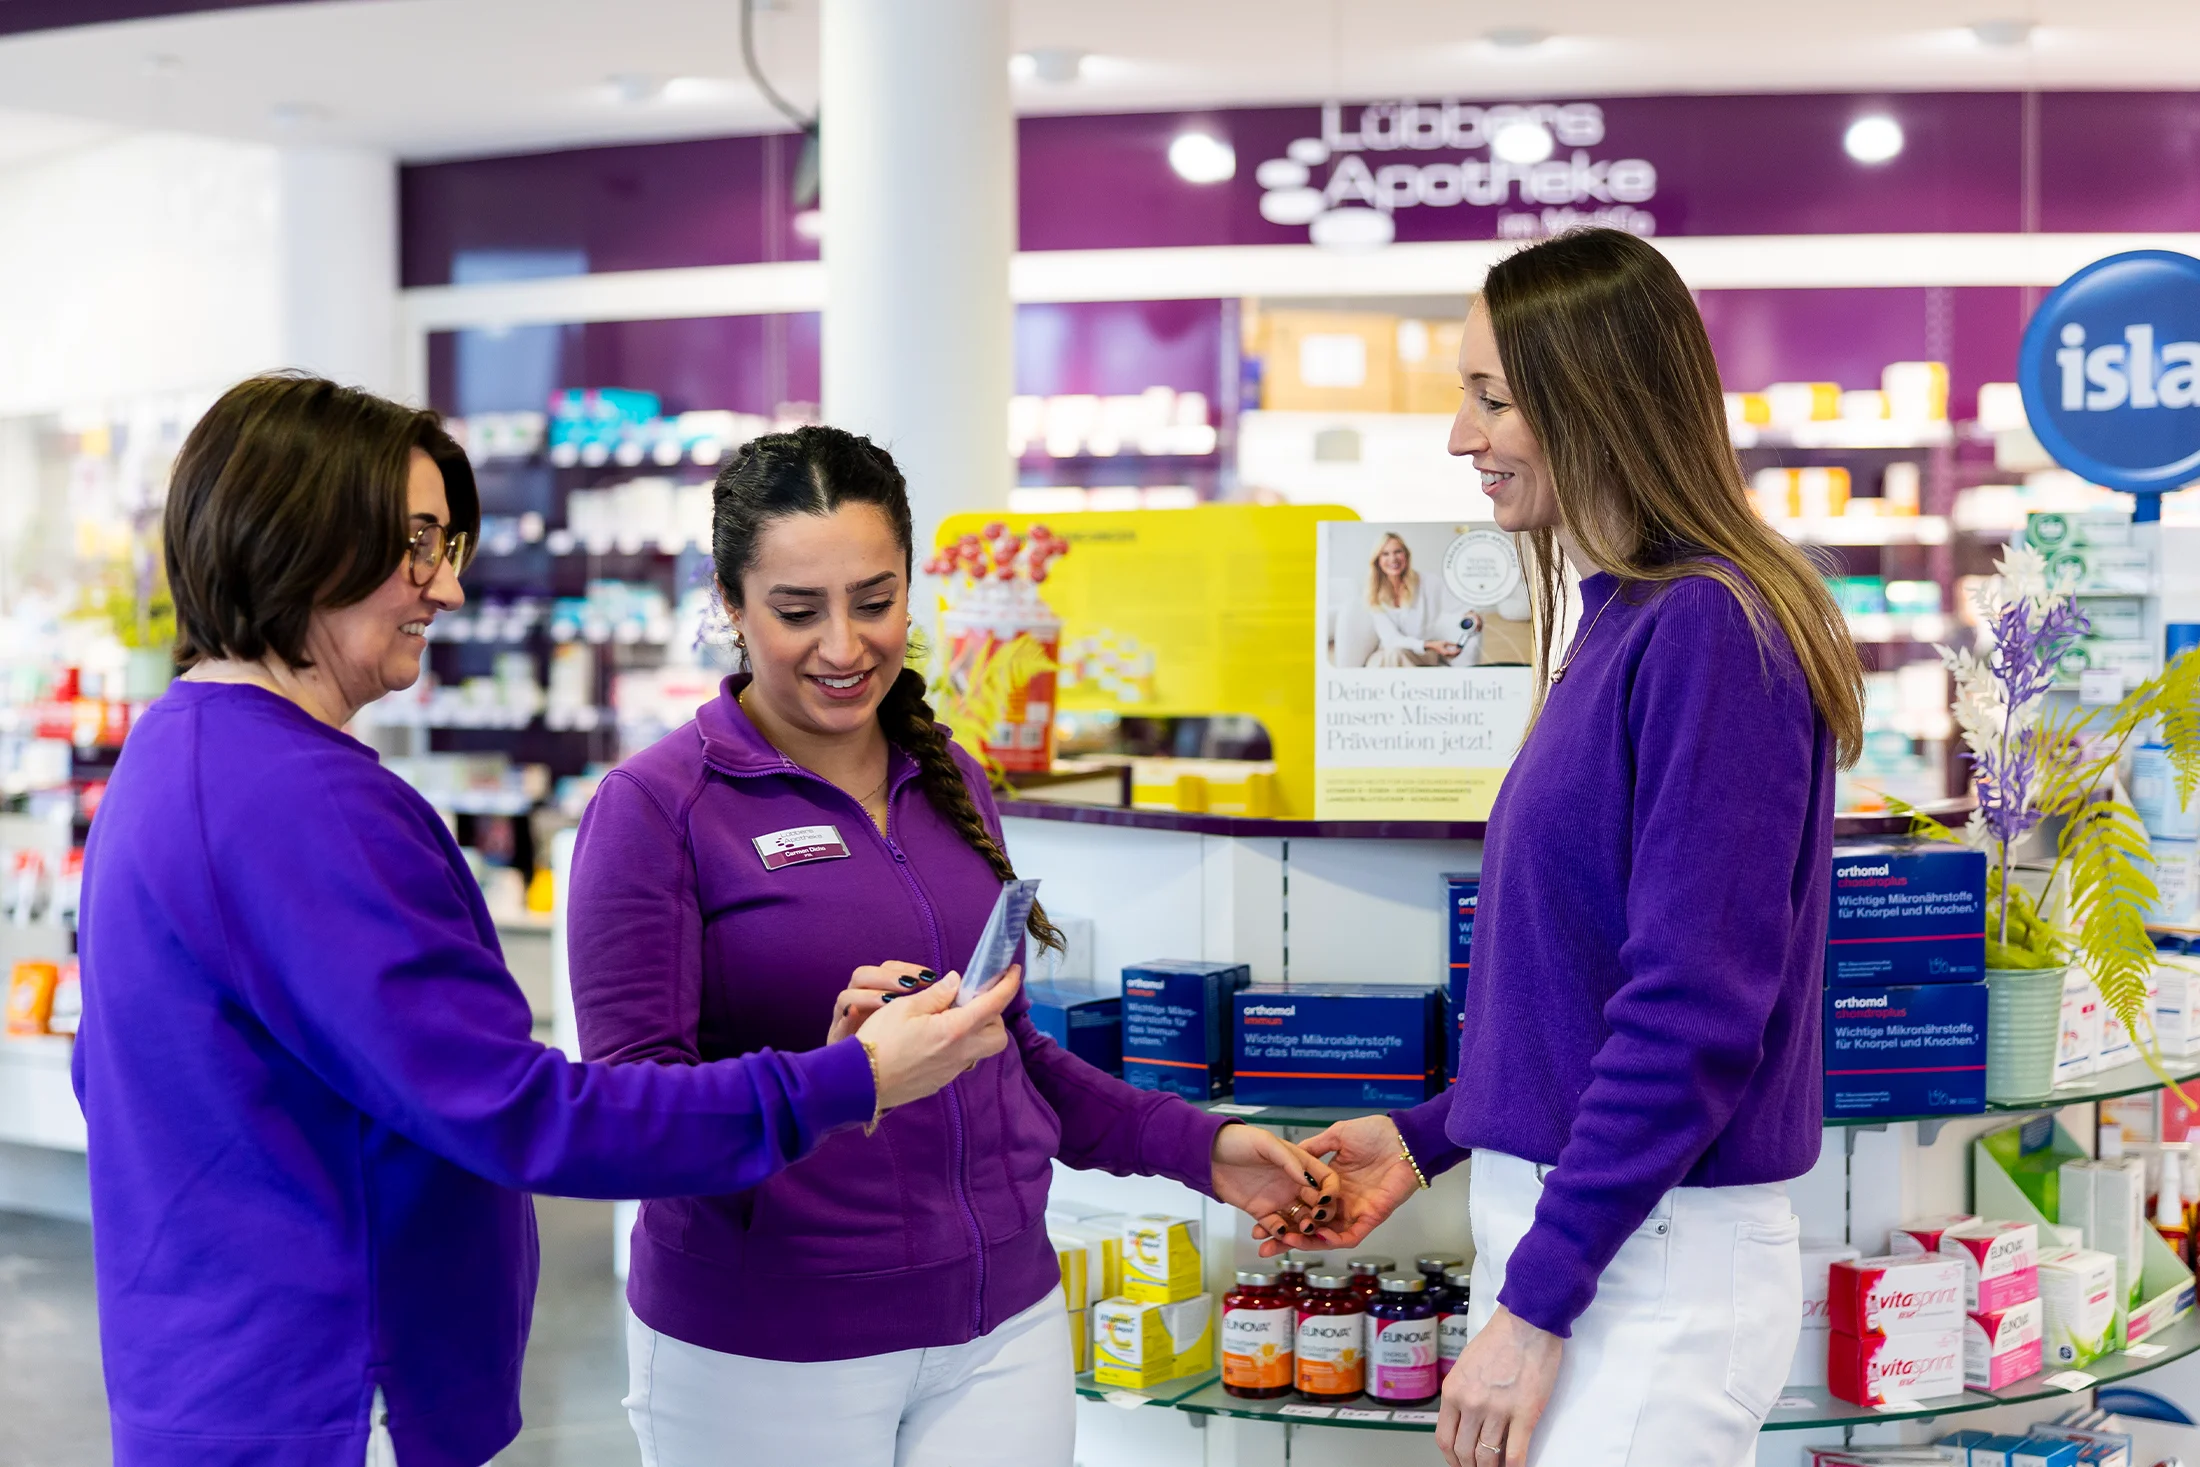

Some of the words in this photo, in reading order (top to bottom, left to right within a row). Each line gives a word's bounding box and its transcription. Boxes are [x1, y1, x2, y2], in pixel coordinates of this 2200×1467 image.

[1322, 102, 1605, 151] Lübbers
[1322, 150, 1657, 213] Apotheke
[1327, 680, 1385, 701] Deine
[1390, 680, 1504, 701] Gesundheit
[1326, 711, 1394, 726] unsere
[1401, 705, 1484, 726] Mission:
[1327, 730, 1435, 751] Prävention
[1438, 730, 1493, 755] jetzt!
[1837, 863, 1889, 878] orthomol
[1838, 876, 1908, 888] chondroplus
[1838, 895, 1886, 908] Wichtige
[1888, 891, 1973, 904] Mikronährstoffe
[1838, 908, 1853, 919] für
[1856, 906, 1900, 919] Knorpel
[1902, 905, 1922, 916] und
[1126, 978, 1165, 990] orthomol
[1127, 1003, 1165, 1015] Wichtige
[1834, 995, 1887, 1009] orthomol
[1244, 1005, 1296, 1016] orthomol
[1835, 1008, 1907, 1019] chondroplus
[1174, 1017, 1188, 1027] für
[1244, 1016, 1283, 1025] immun
[1128, 1024, 1145, 1034] das
[1835, 1026, 1884, 1038] Wichtige
[1887, 1023, 1974, 1036] Mikronährstoffe
[1244, 1033, 1299, 1047] Wichtige
[1302, 1034, 1402, 1046] Mikronährstoffe
[1836, 1039, 1852, 1049] für
[1854, 1038, 1898, 1050] Knorpel
[1900, 1037, 1922, 1048] und
[1244, 1046, 1262, 1056] für
[1265, 1047, 1288, 1057] das
[1880, 1287, 1957, 1310] vitasprint
[1302, 1325, 1351, 1338] EUNOVA
[1382, 1331, 1432, 1343] EUNOVA
[1881, 1353, 1956, 1377] vitasprint
